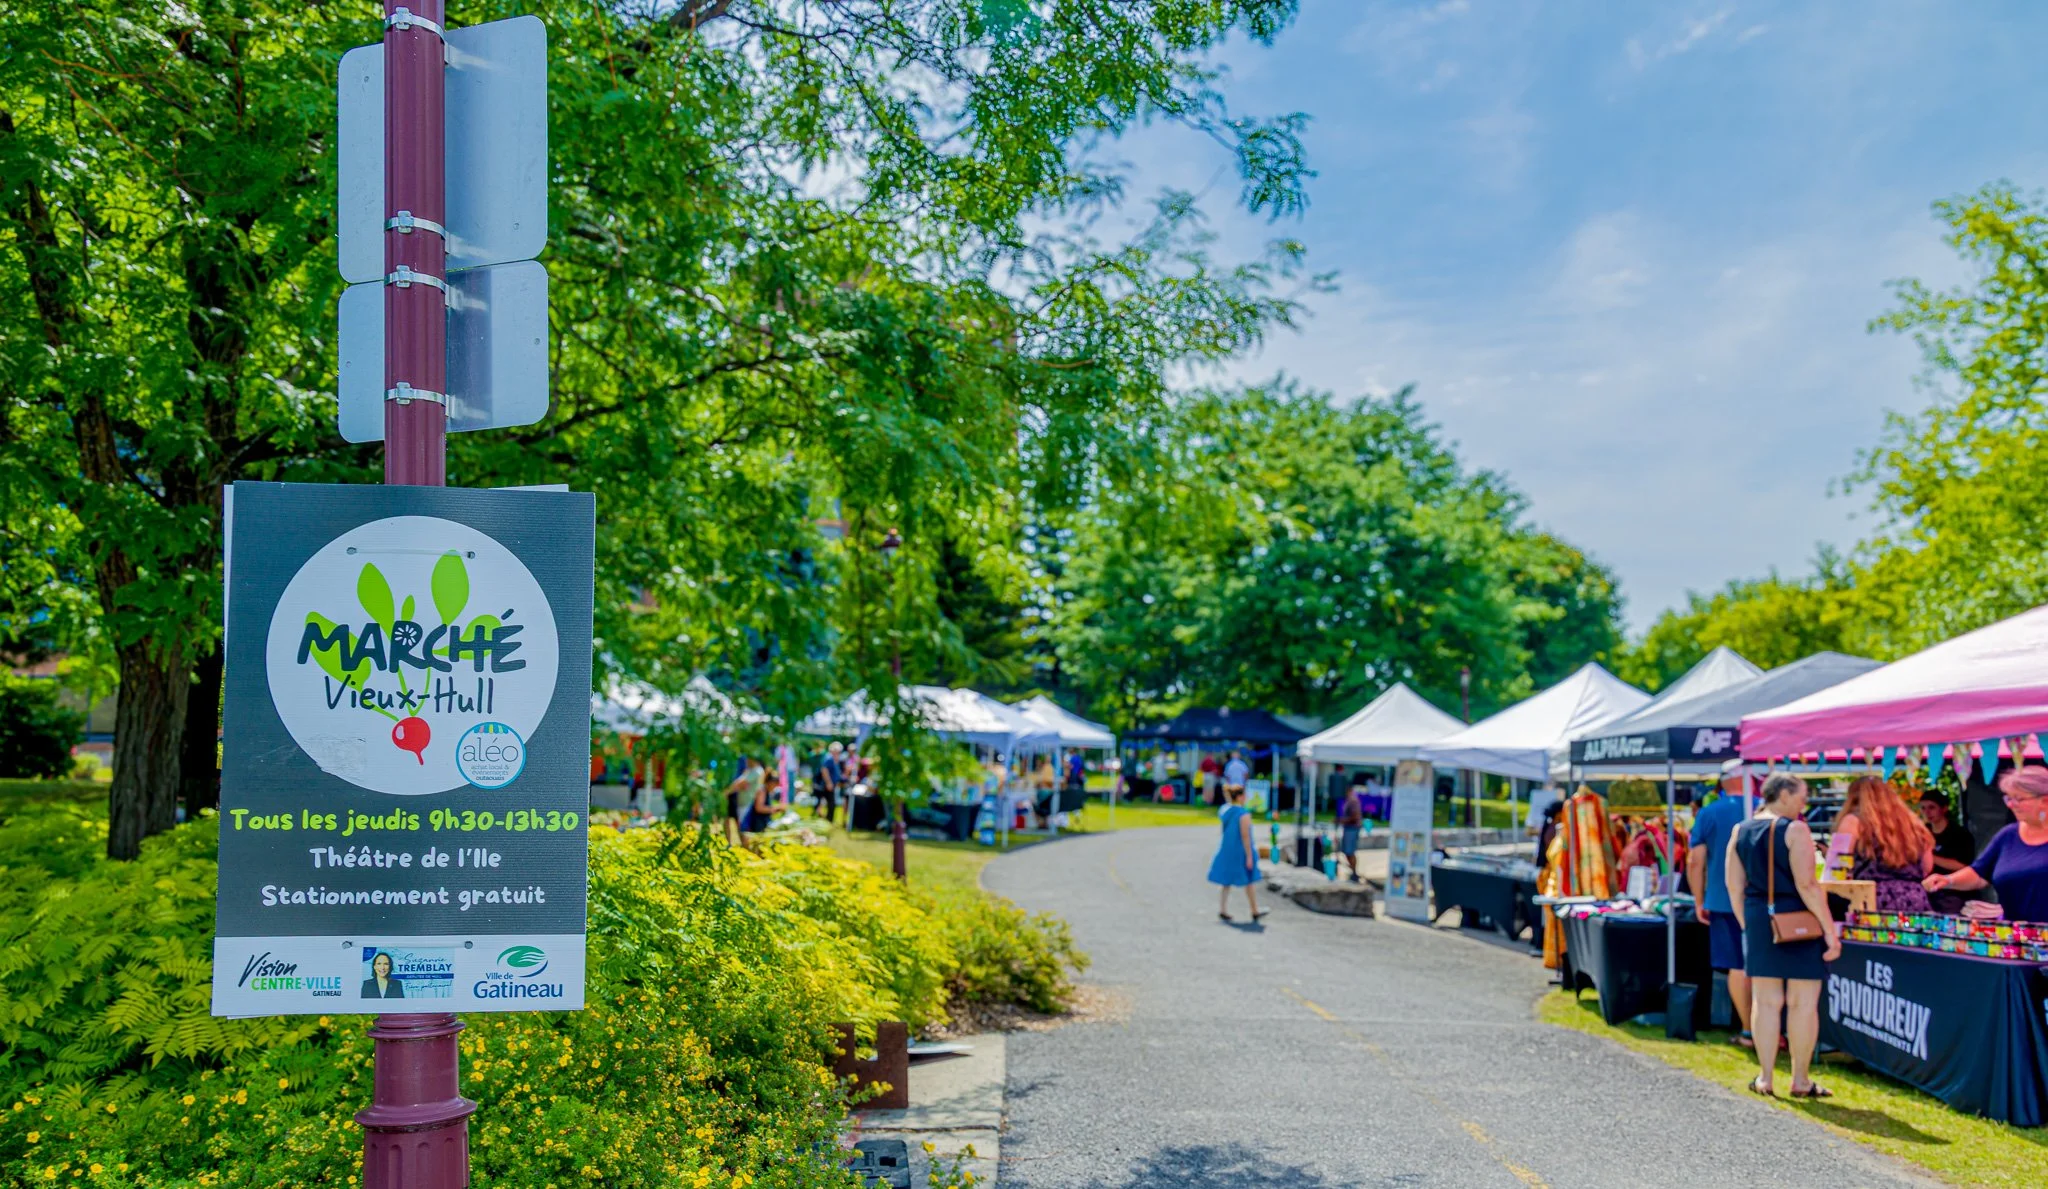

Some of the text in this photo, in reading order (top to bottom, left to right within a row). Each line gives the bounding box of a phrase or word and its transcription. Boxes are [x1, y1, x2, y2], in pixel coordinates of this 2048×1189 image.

[297, 609, 527, 674] MARCHÉ
[324, 674, 494, 714] Vieux-Hull
[462, 737, 519, 762] aléo
[229, 808, 579, 837] Tous les jeudis 9h30-13h30
[309, 846, 502, 868] Théâtre de l'Ile
[261, 884, 546, 912] Stationnement gratuit
[238, 952, 298, 988] Vision
[398, 964, 453, 972] TREMBLAY
[485, 972, 514, 980] Ville de
[1865, 959, 1893, 991] LES
[251, 976, 342, 991] CENTRE-VILLE
[473, 981, 563, 999] Gatineau
[1827, 972, 1931, 1061] SAVOUREUX
